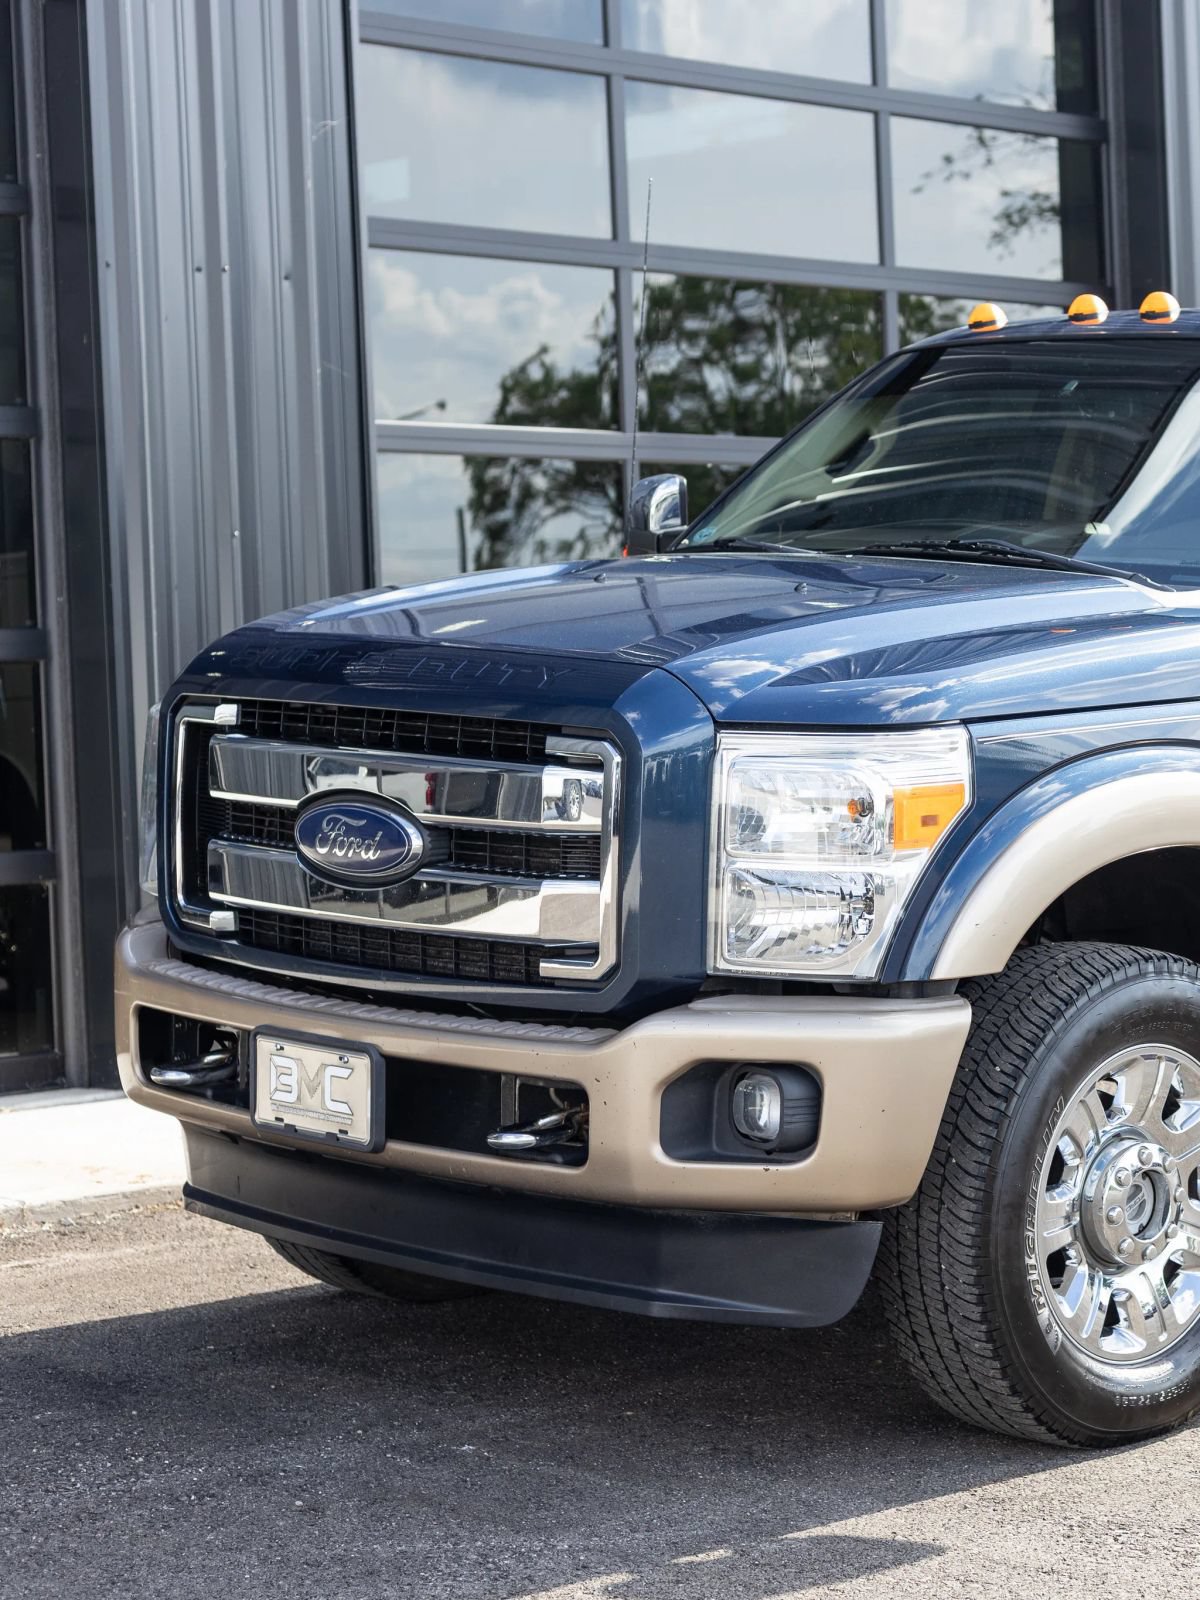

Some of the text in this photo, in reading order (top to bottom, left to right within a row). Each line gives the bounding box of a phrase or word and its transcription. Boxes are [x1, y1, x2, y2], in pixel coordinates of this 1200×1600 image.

[315, 814, 383, 860] Ford
[270, 1053, 354, 1116] BMC
[1024, 1095, 1066, 1316] MICHELIN
